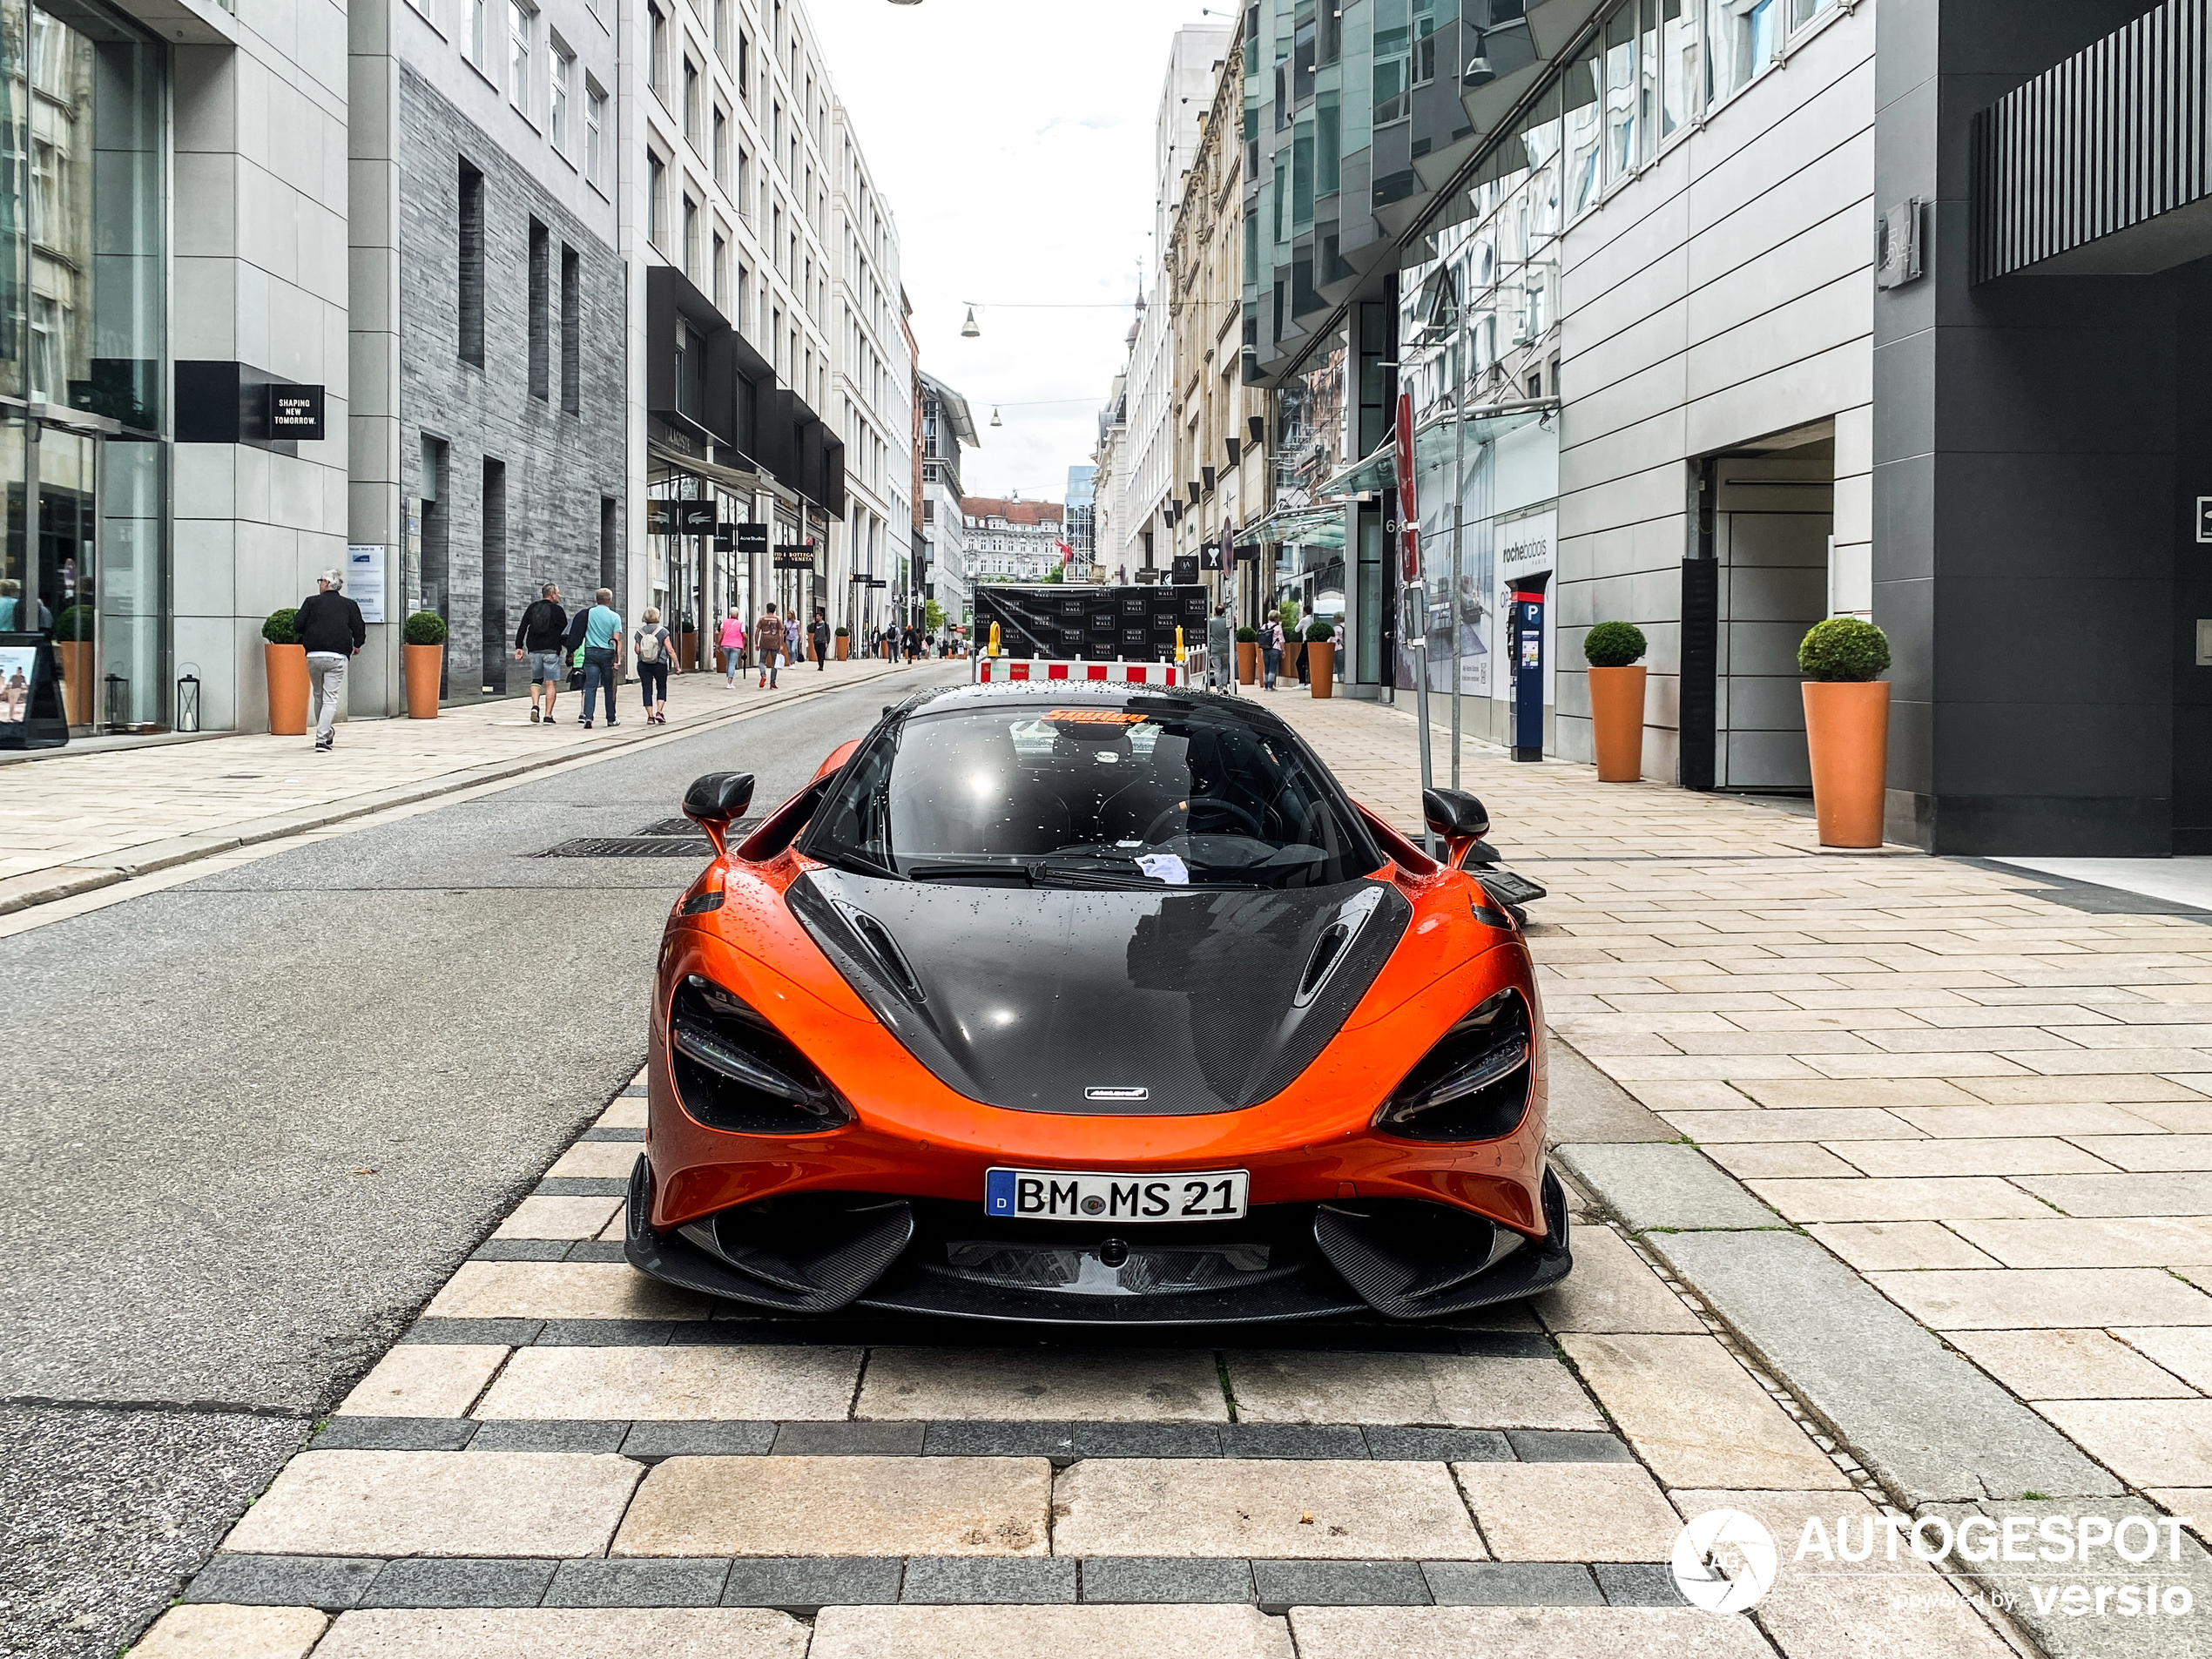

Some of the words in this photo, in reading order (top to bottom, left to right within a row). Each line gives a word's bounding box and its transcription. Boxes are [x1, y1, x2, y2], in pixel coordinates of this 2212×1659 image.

[1885, 220, 1912, 269] 54
[279, 399, 310, 408] SHAPING
[1527, 604, 1538, 621] P
[996, 1197, 1007, 1209] D
[1017, 1178, 1078, 1215] BM
[1109, 1182, 1170, 1217] MS
[1182, 1179, 1238, 1216] 21
